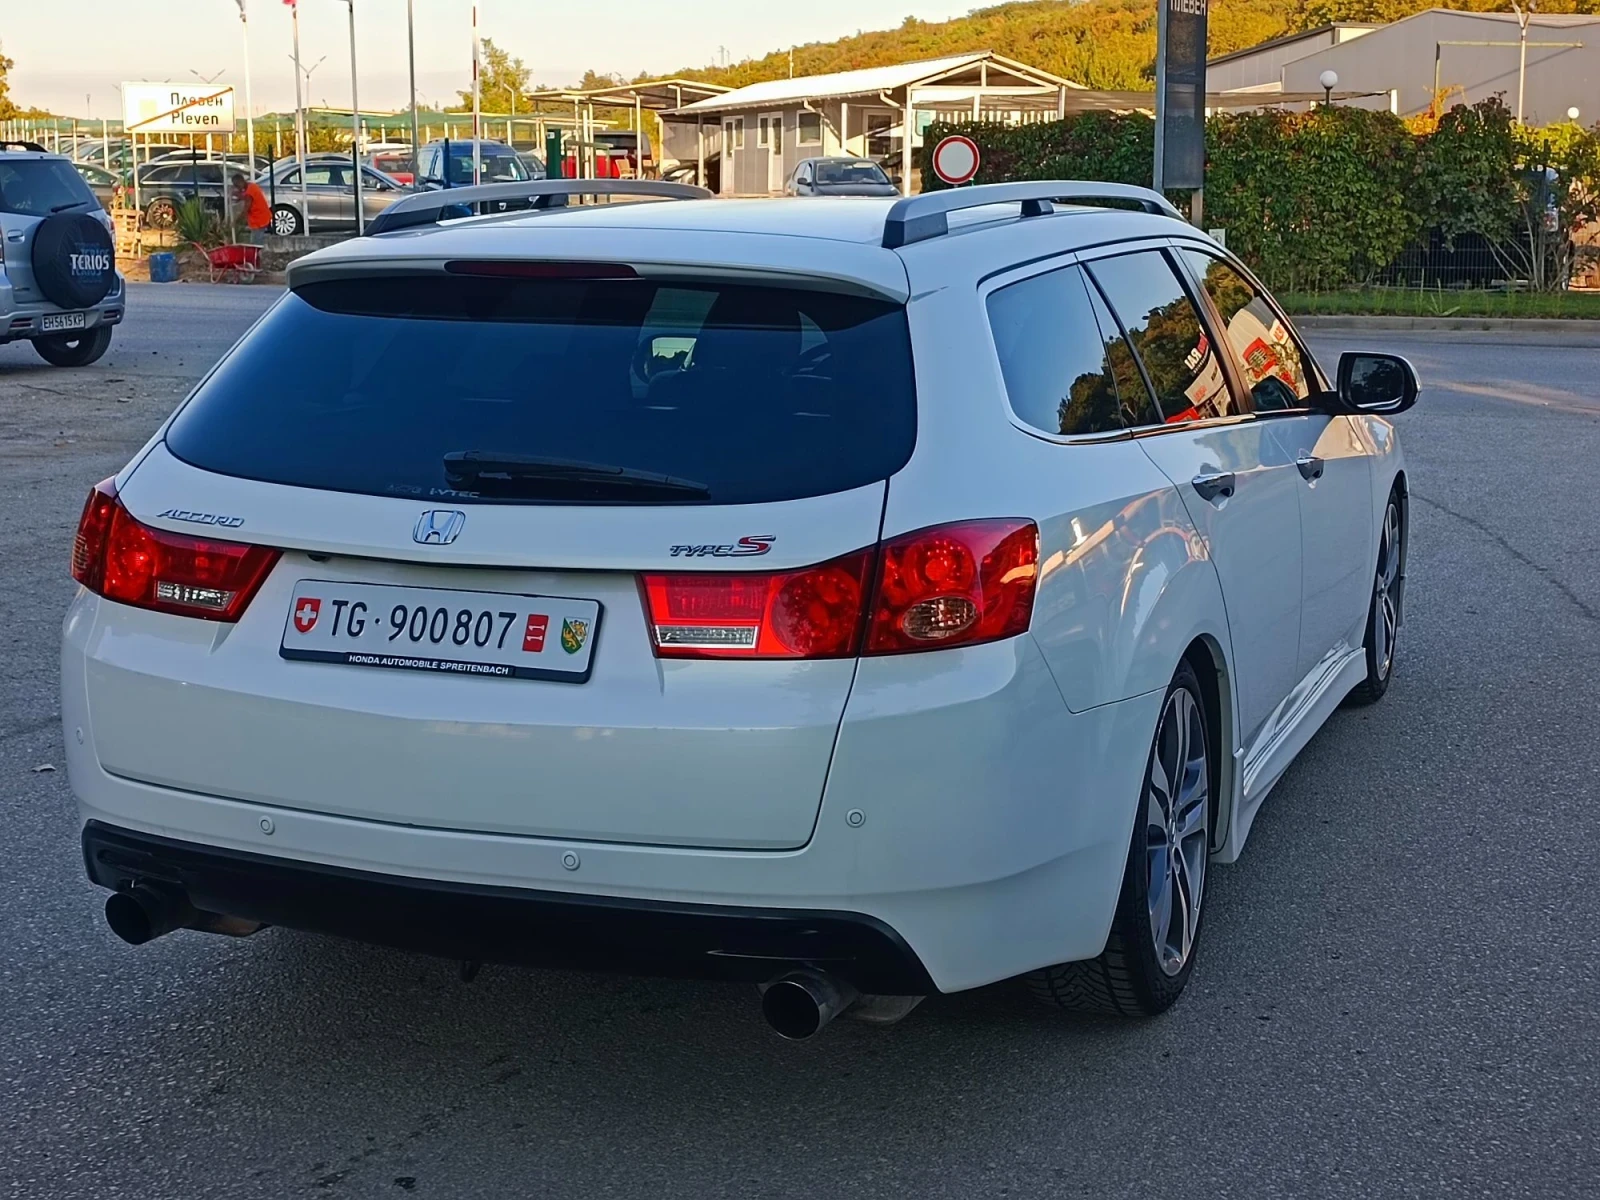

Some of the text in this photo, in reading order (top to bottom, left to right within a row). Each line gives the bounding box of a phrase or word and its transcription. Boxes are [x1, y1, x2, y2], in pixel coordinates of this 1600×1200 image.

[171, 111, 219, 125] Pleven
[69, 253, 110, 270] TERIOS
[156, 509, 245, 528] ACCORD
[669, 534, 777, 557] TYPE S
[348, 654, 509, 675] HONDA AUTOMOBILE SPREITENBACH
